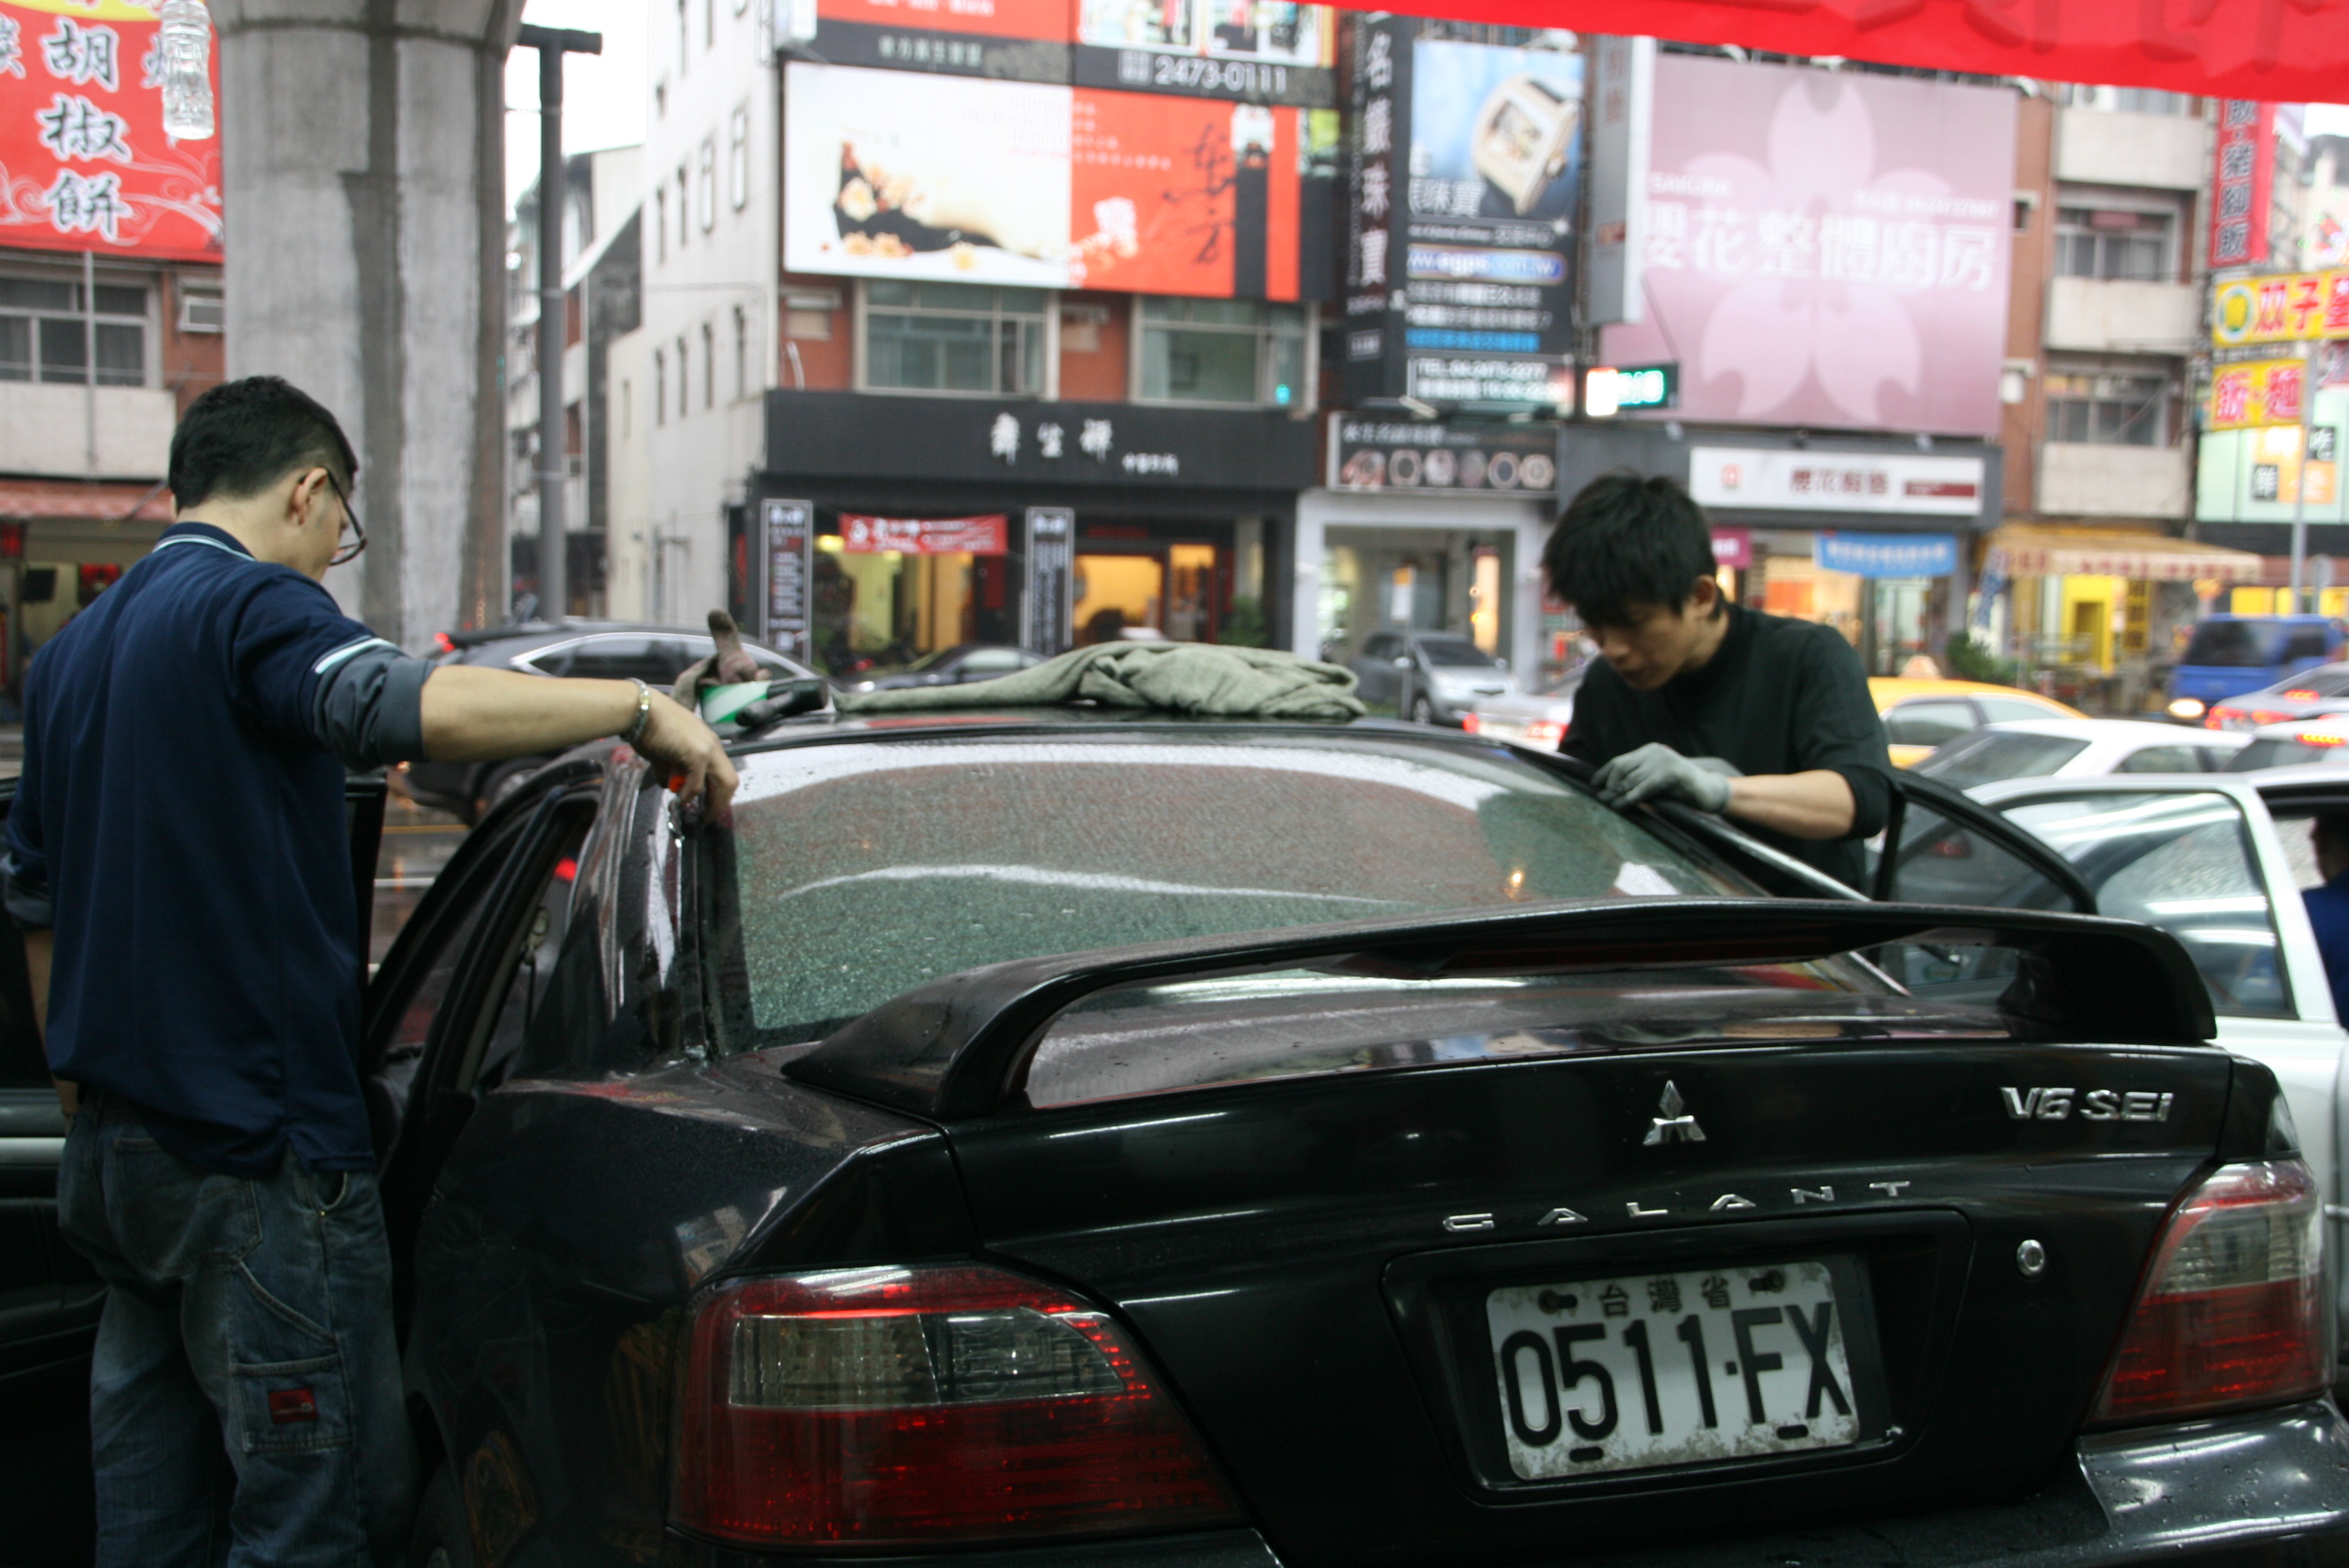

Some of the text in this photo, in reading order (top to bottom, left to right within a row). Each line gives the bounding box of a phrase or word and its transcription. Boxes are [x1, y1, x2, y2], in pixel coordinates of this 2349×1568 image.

[1154, 55, 1287, 94] 2473-0111
[37, 17, 132, 244] 胡椒餅
[2000, 1087, 2076, 1119] V6
[1442, 1180, 1910, 1233] GALANT
[1598, 1276, 1733, 1319] 台灣省
